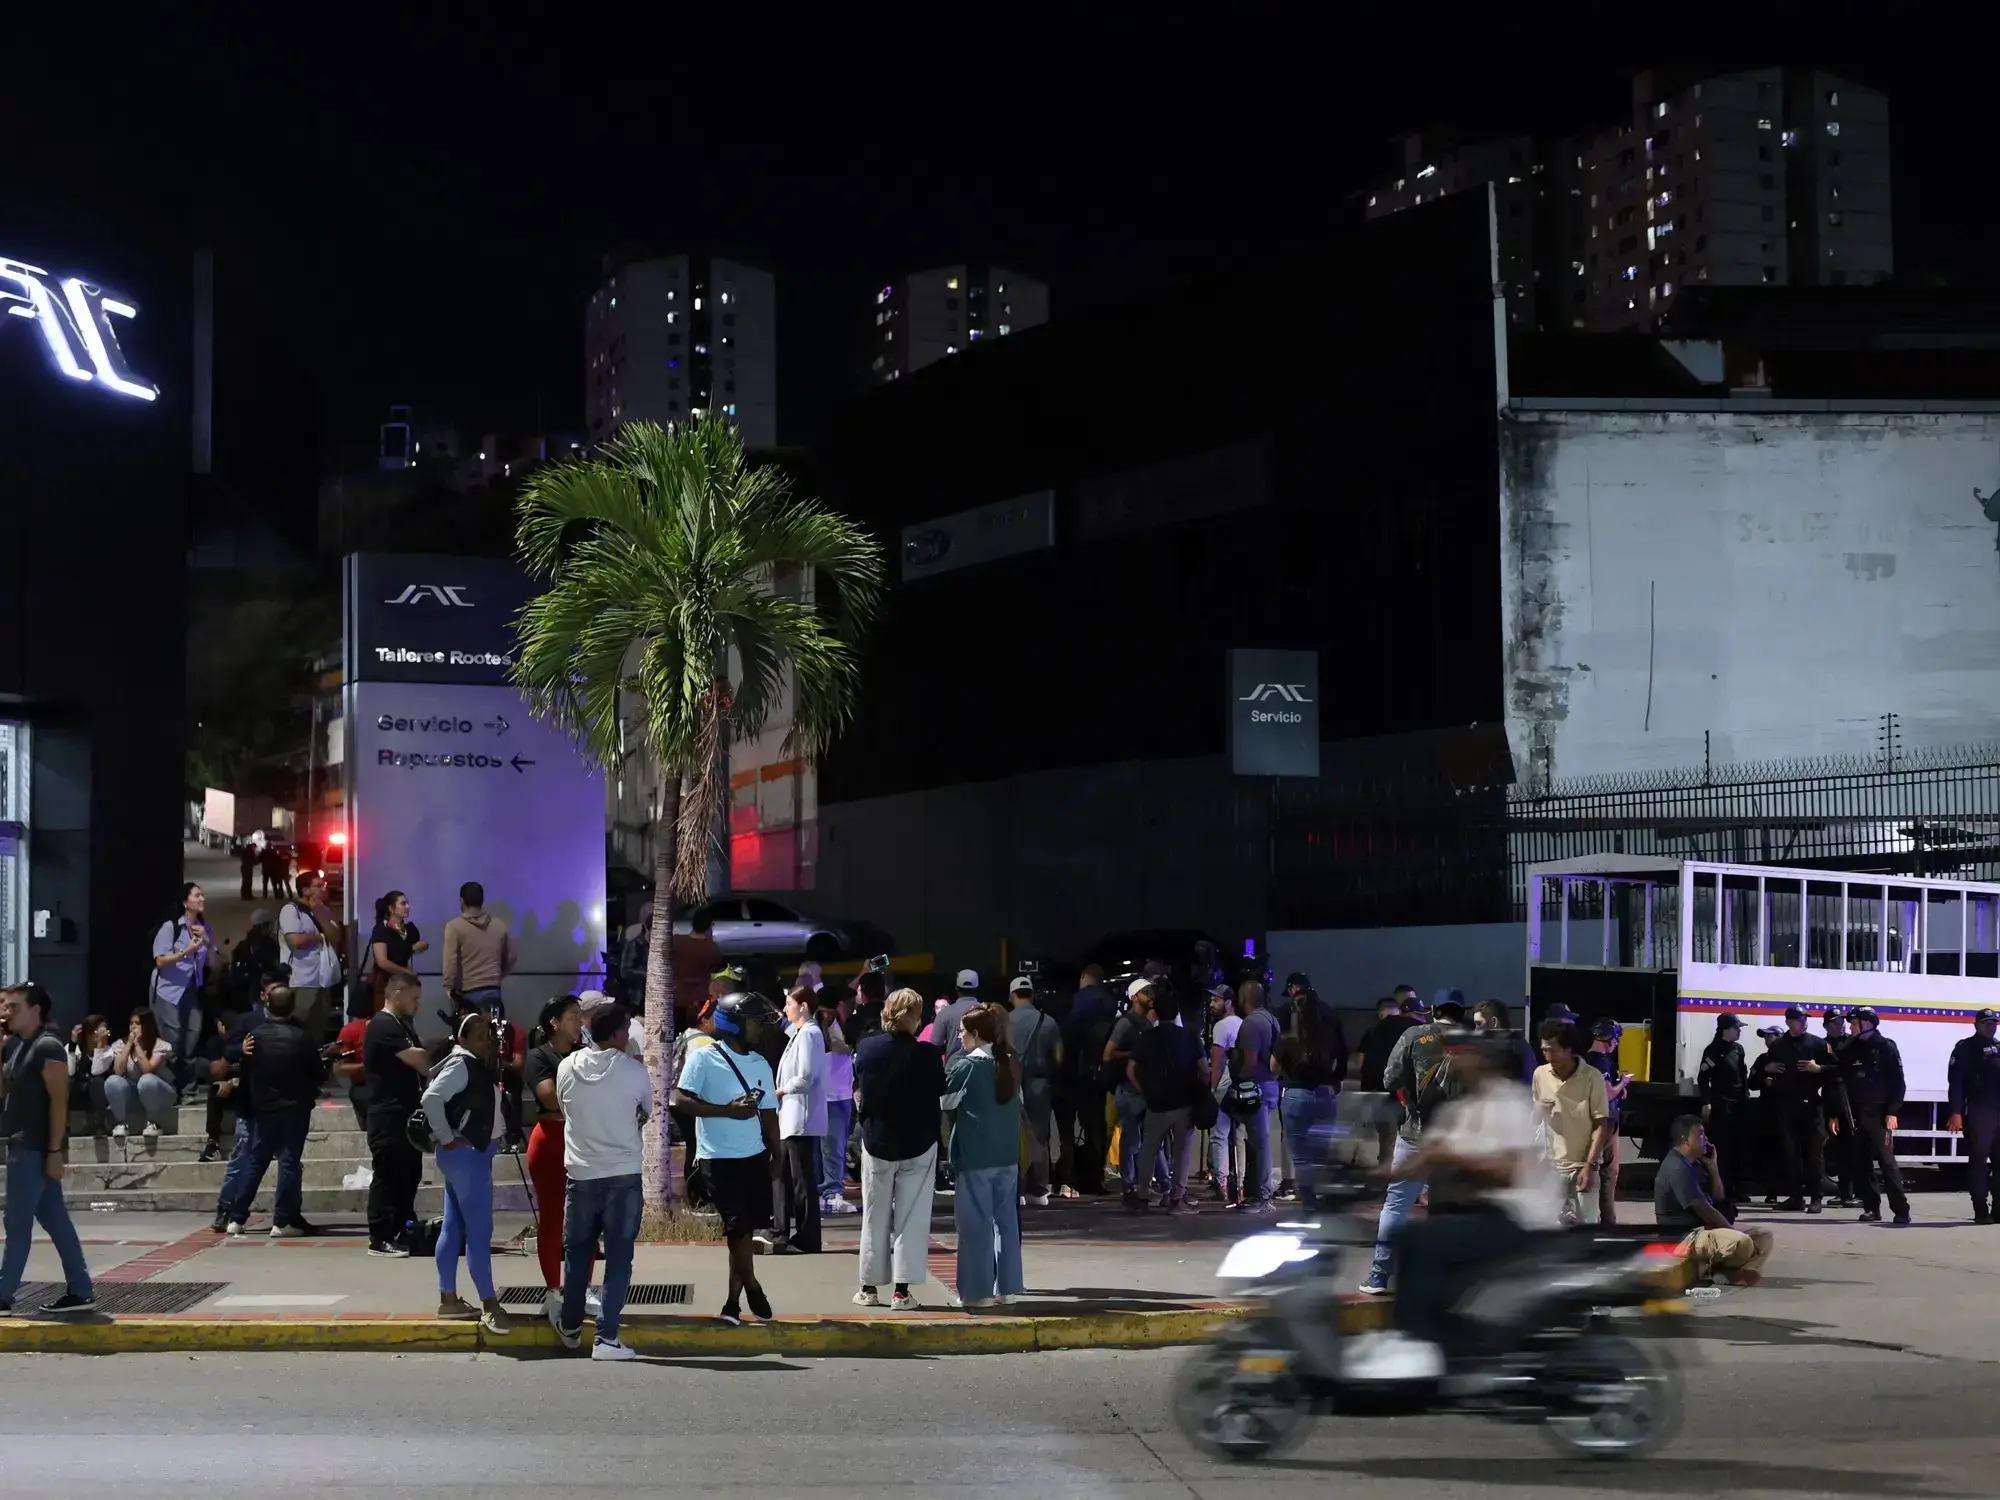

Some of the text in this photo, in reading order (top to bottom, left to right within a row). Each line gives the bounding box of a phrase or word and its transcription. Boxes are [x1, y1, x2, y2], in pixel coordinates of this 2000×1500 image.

[0, 256, 161, 402] AC
[384, 584, 475, 607] JAC
[375, 647, 445, 664] Talleres
[1239, 683, 1313, 702] JAC
[377, 714, 473, 734] Servicio
[1250, 709, 1302, 723] Servicio
[377, 749, 503, 770] Repuestos
